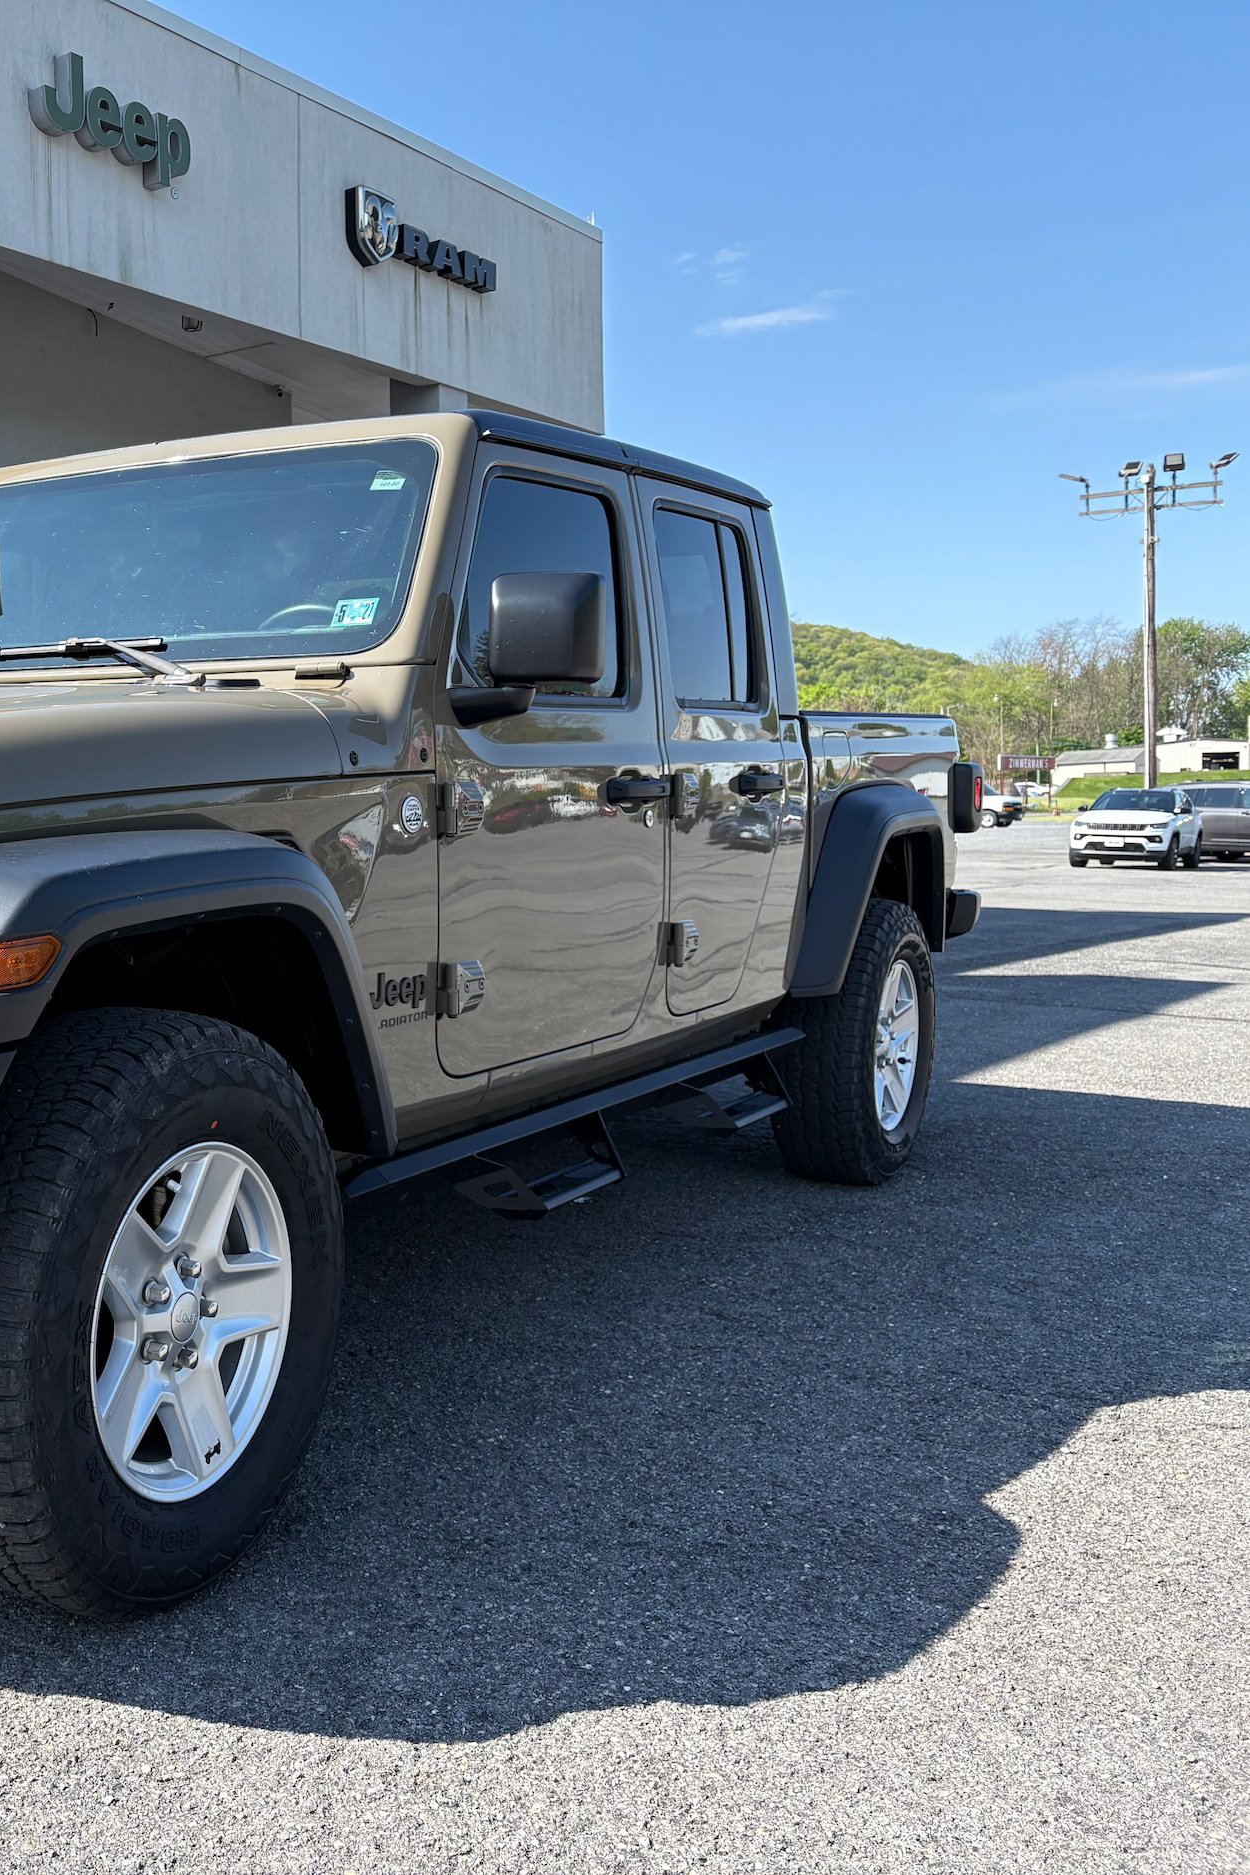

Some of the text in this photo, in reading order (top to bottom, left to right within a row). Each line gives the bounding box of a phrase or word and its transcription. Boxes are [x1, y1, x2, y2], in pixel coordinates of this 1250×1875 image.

[29, 52, 191, 190] Jeep
[397, 223, 496, 293] RAM
[369, 972, 428, 1010] Jeep
[256, 1110, 330, 1271] NEXEN
[175, 1309, 198, 1325] Jeep
